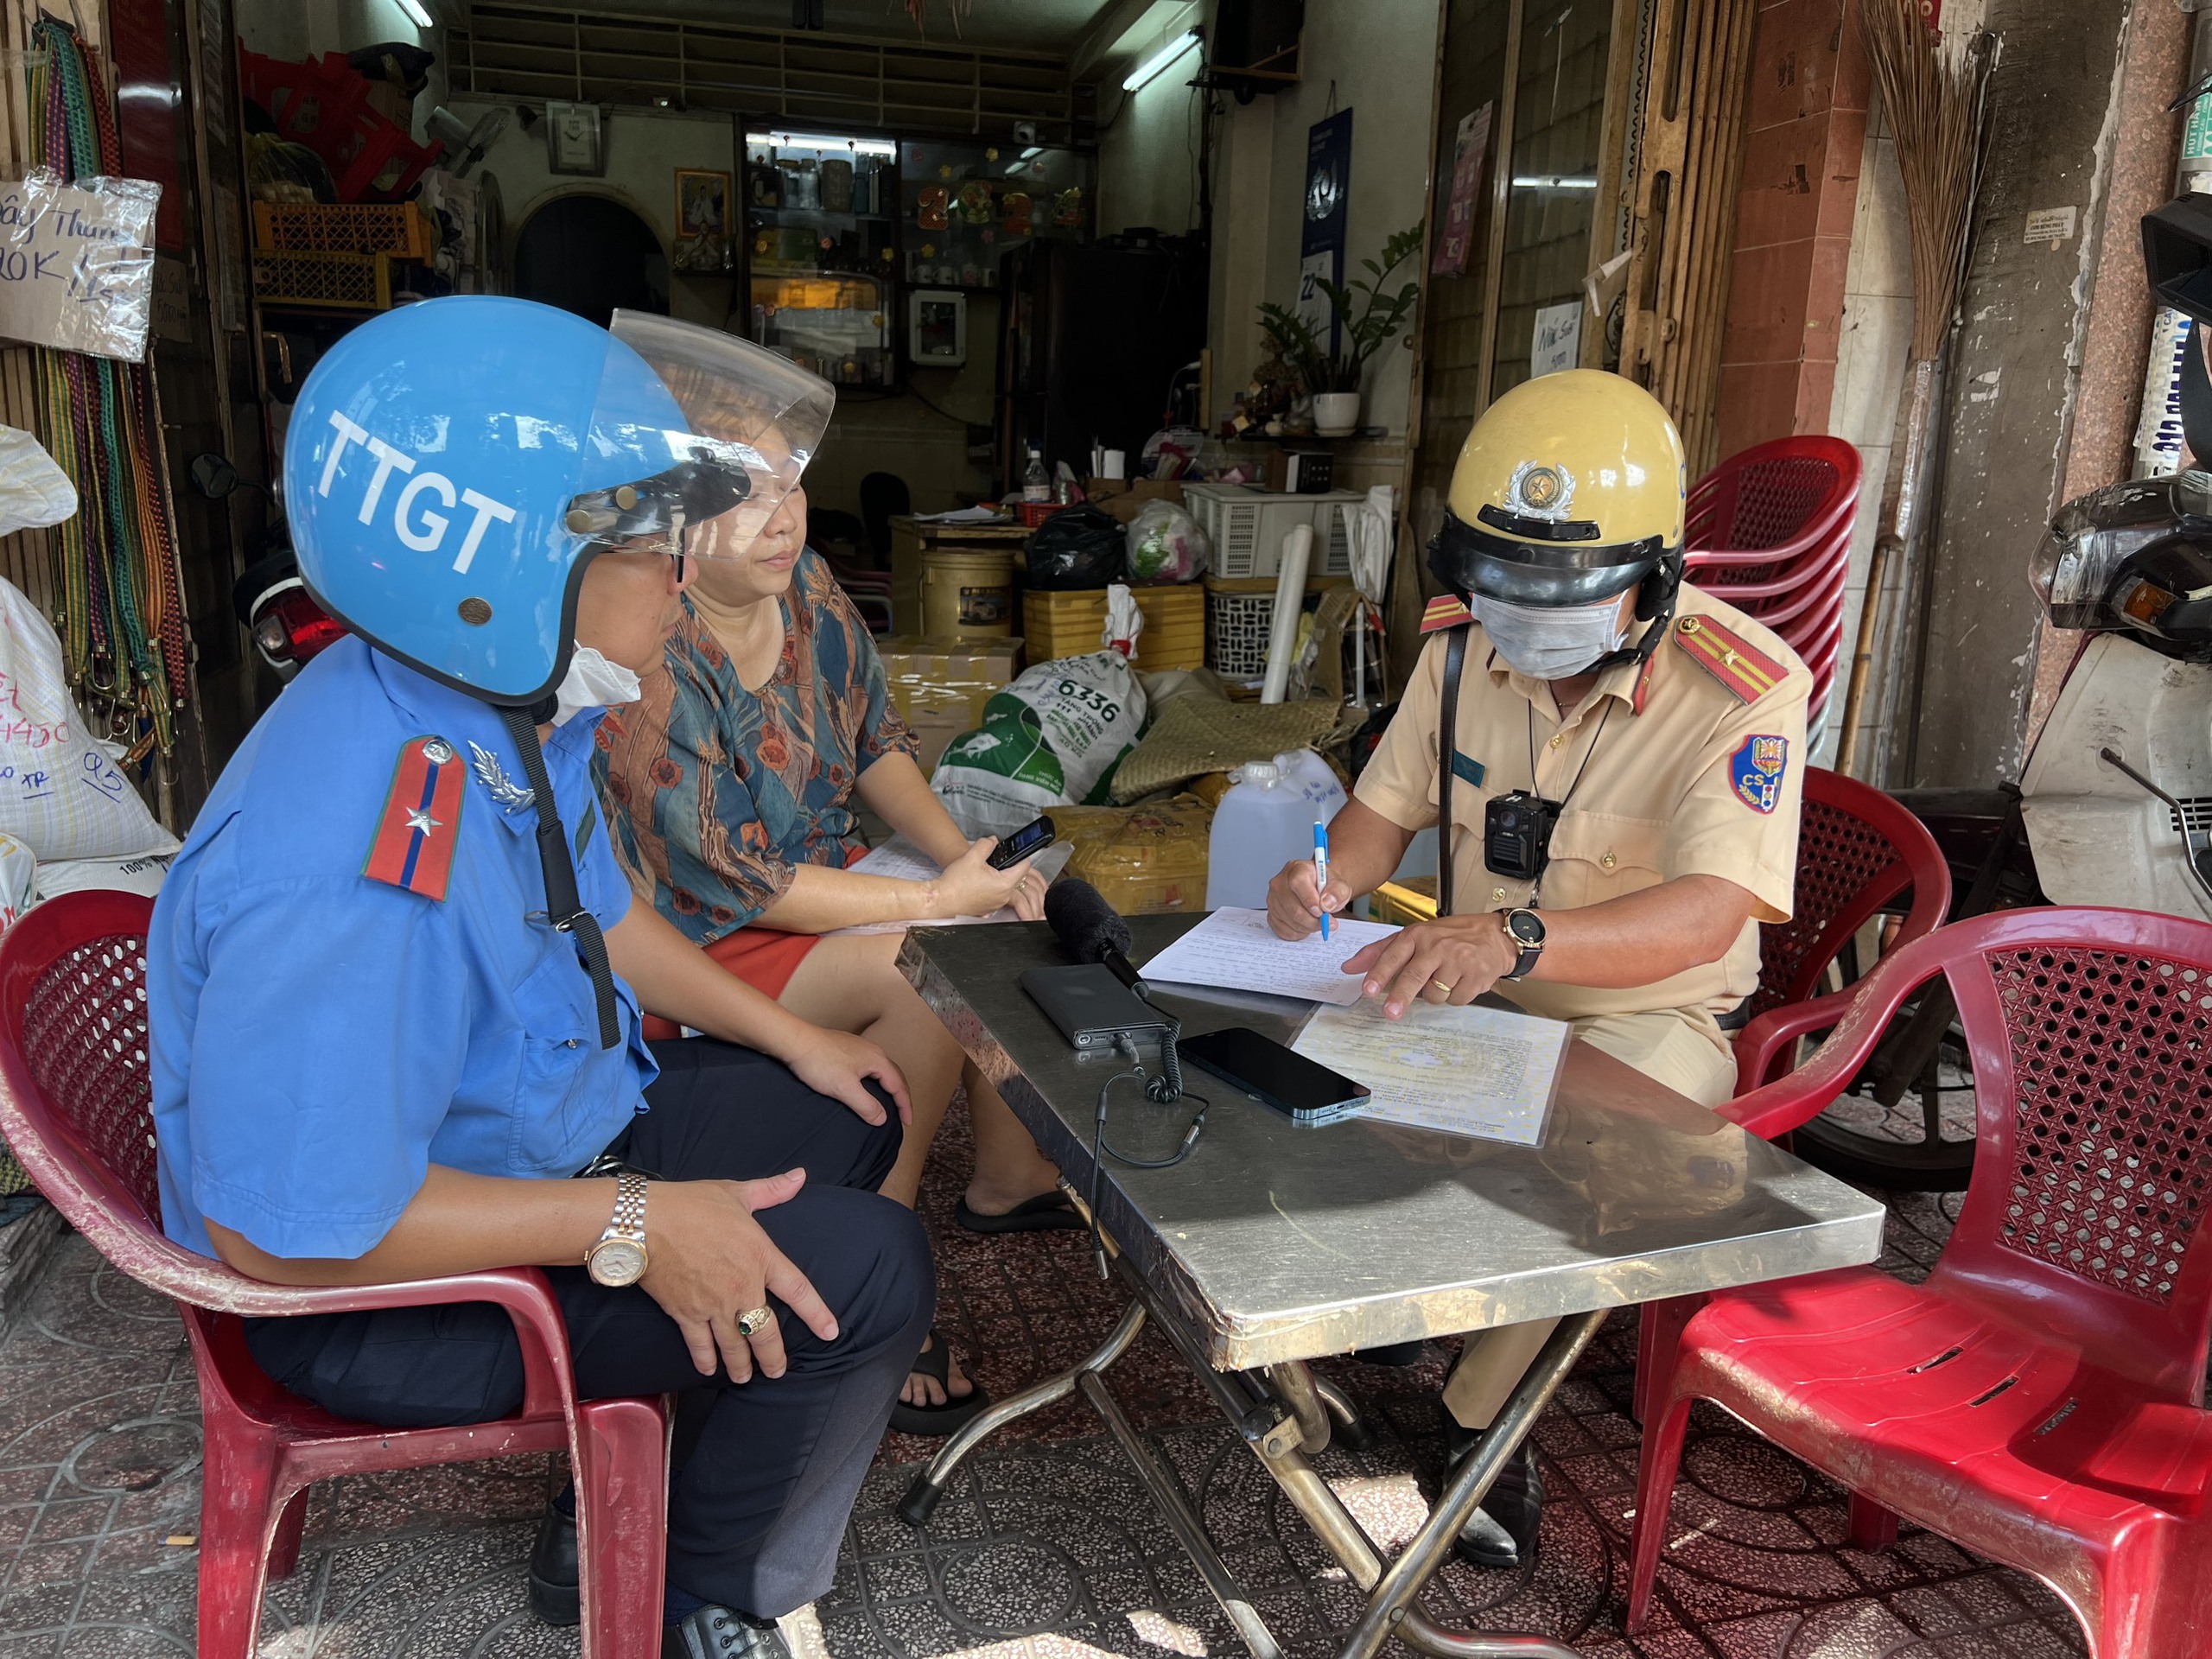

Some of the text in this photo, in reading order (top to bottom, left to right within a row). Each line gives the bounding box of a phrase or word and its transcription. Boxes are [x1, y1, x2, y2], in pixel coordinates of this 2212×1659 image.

[318, 410, 517, 575] TTGT
[1058, 679, 1121, 723] 6336
[119, 859, 153, 875] 100%
